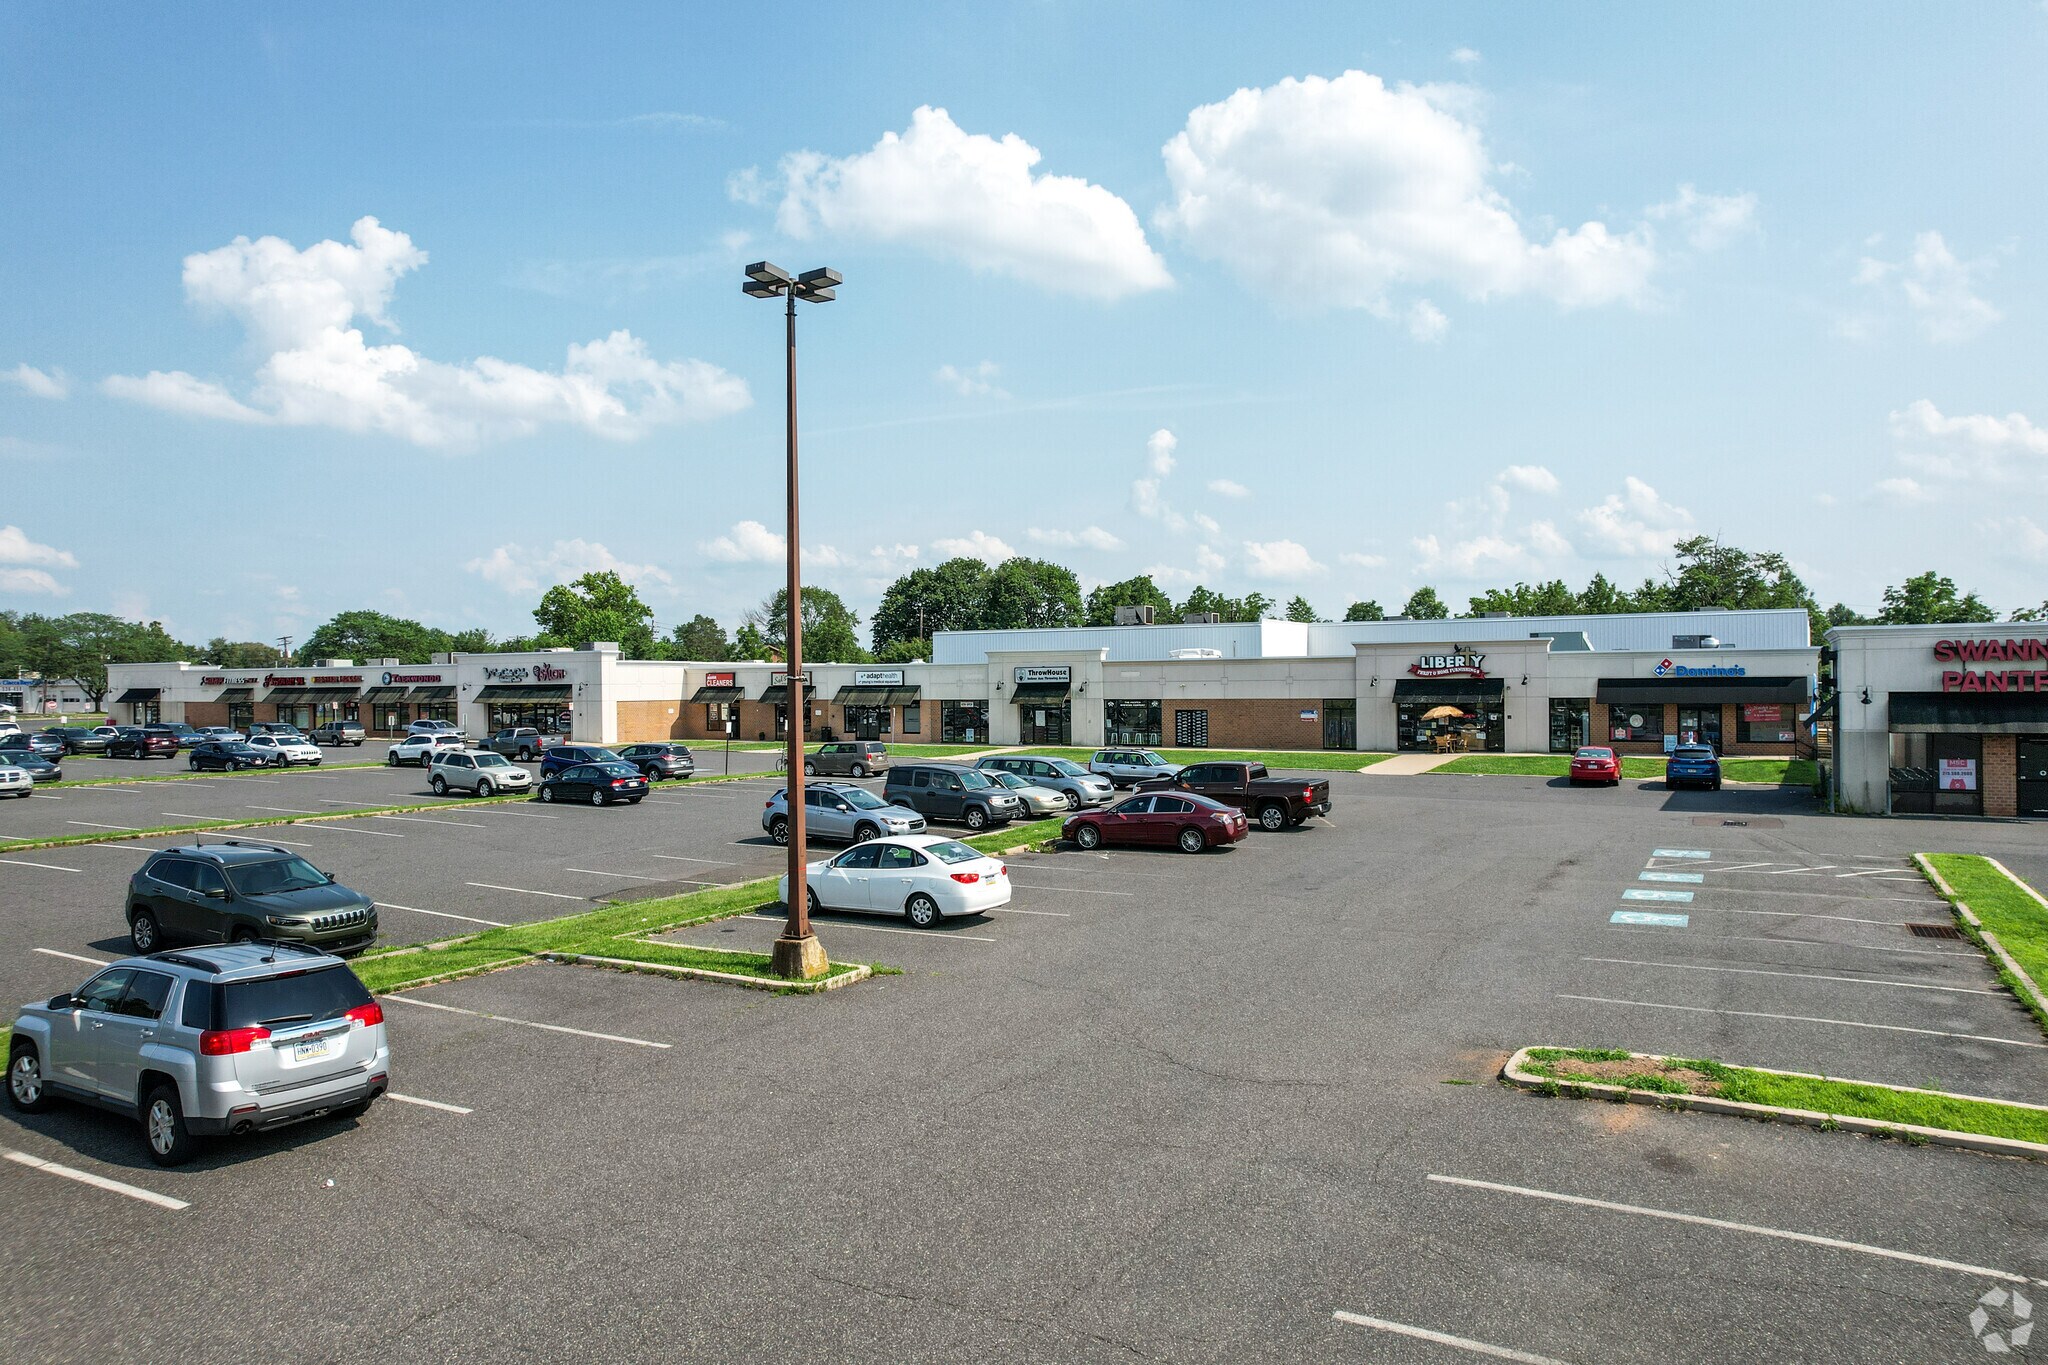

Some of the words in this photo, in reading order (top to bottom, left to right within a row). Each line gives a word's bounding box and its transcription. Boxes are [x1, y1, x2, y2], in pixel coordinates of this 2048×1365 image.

[1935, 638, 2048, 662] SWANN
[1421, 649, 1484, 668] LIBERTY
[866, 672, 898, 680] adapthealth
[1676, 664, 1746, 677] Domino's
[393, 674, 441, 683] TAEKWONDO
